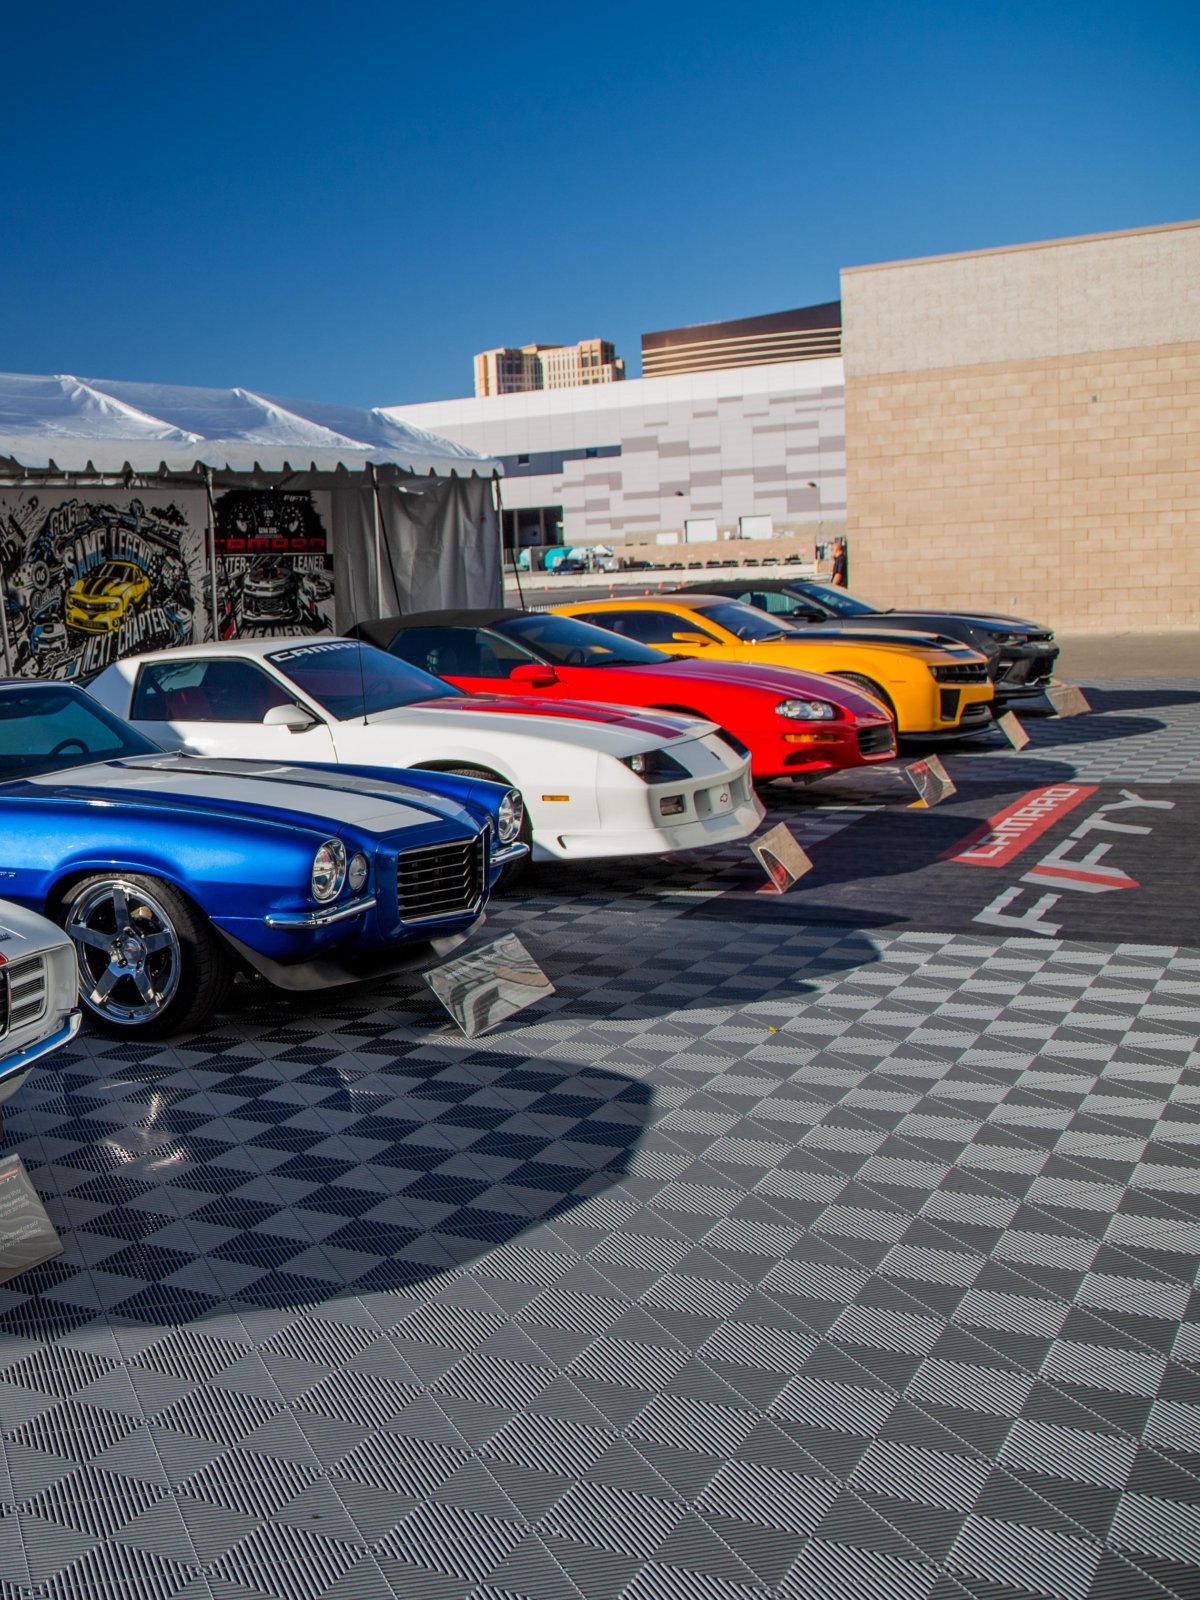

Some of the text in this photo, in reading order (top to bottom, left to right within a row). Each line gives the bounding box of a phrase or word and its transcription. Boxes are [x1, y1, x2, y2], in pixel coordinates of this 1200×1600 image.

[65, 528, 108, 587] SAME
[111, 527, 154, 573] LEGEND
[206, 555, 326, 574] LGHTER LEANER
[82, 631, 114, 674] NEXT
[117, 607, 170, 656] CHAPTER
[957, 786, 1081, 860] CAMARO
[971, 789, 1177, 936] FIFTY
